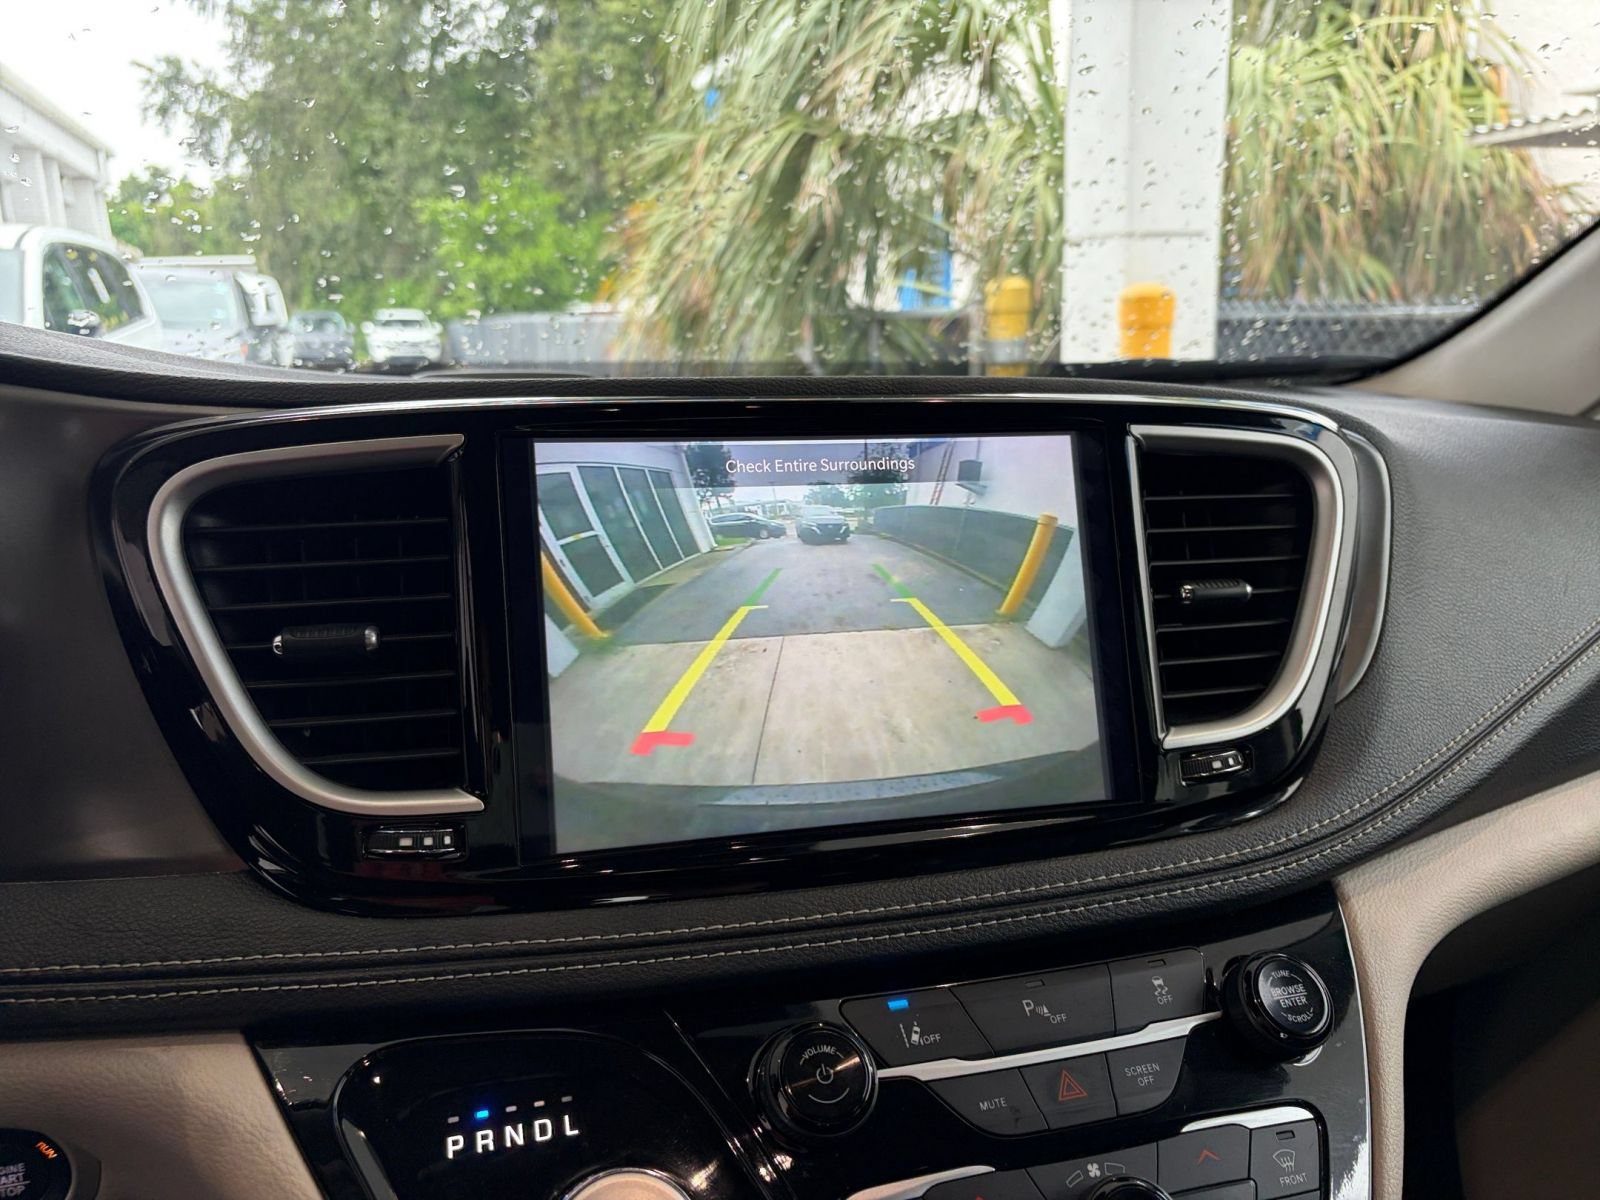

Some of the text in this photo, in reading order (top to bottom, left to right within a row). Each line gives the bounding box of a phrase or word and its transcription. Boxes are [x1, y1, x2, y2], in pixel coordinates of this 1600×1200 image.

[725, 456, 916, 473] Check Entire Surroundings
[1271, 969, 1290, 979] TUNE
[1270, 983, 1306, 997] BROWSE
[1156, 995, 1173, 1005] OFF
[1280, 996, 1308, 1008] ENTER
[1022, 999, 1068, 1024] P OFF
[1287, 1010, 1314, 1023] SCROLL
[923, 1033, 942, 1045] OFF
[802, 1044, 836, 1060] VOLUME
[1124, 1063, 1161, 1077] SCREEN
[1137, 1075, 1155, 1087] OFF
[979, 1097, 1008, 1112] MUTE
[446, 1114, 580, 1159] P R N D L
[35, 1141, 58, 1159] RUN
[1279, 1172, 1308, 1187] FRONT
